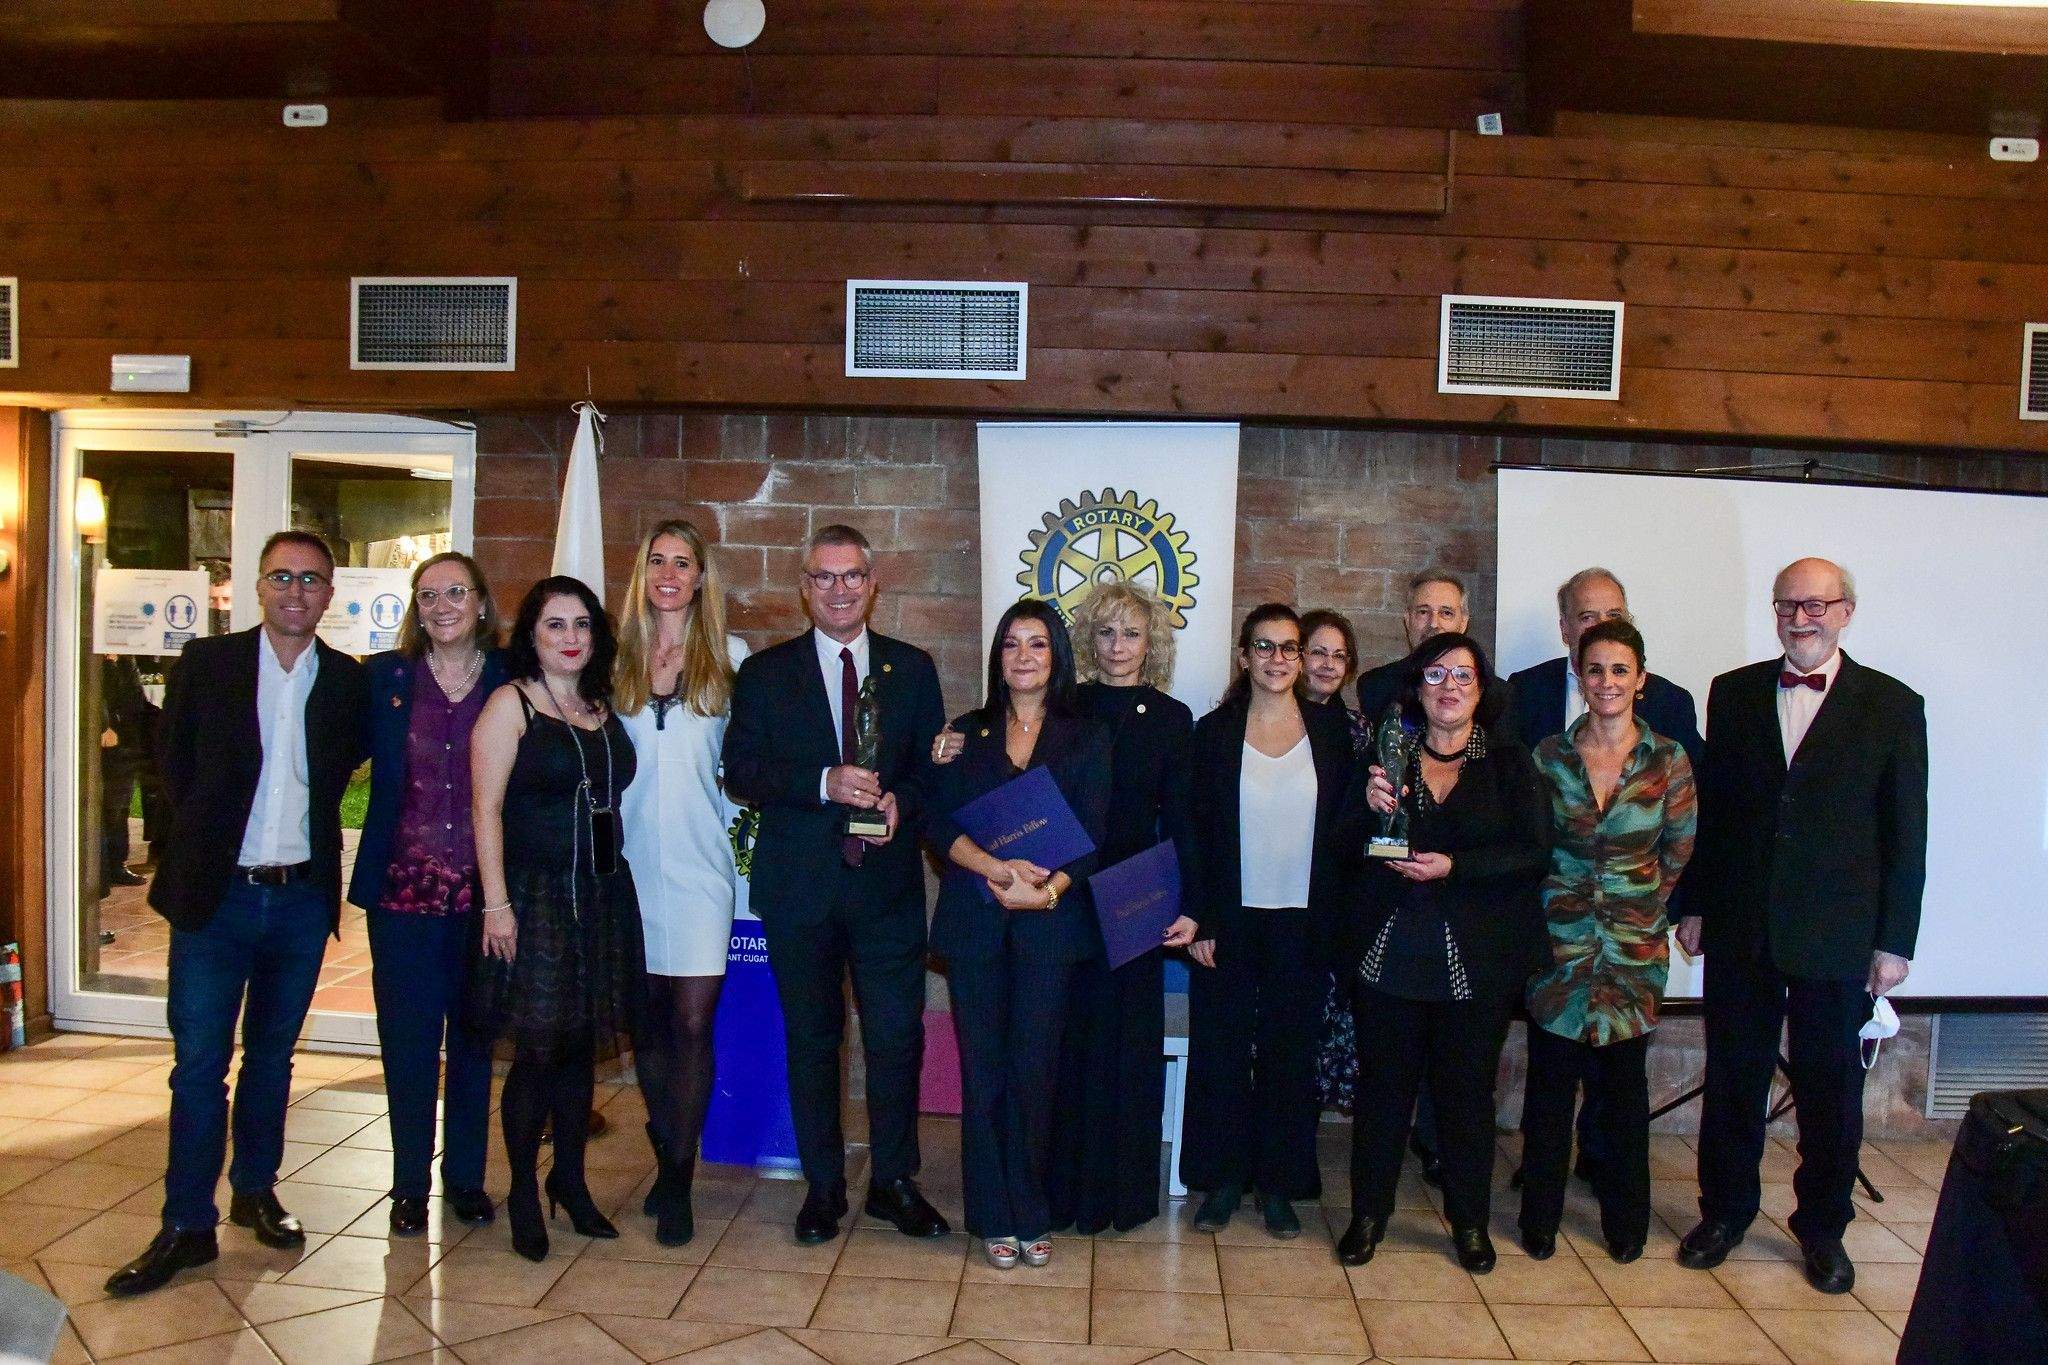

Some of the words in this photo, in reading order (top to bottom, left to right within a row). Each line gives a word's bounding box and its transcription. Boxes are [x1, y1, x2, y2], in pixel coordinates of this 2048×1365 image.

[1072, 510, 1146, 531] ROTARY
[730, 936, 768, 951] OTAR
[727, 953, 742, 962] ANT
[743, 954, 769, 963] CUGAT
